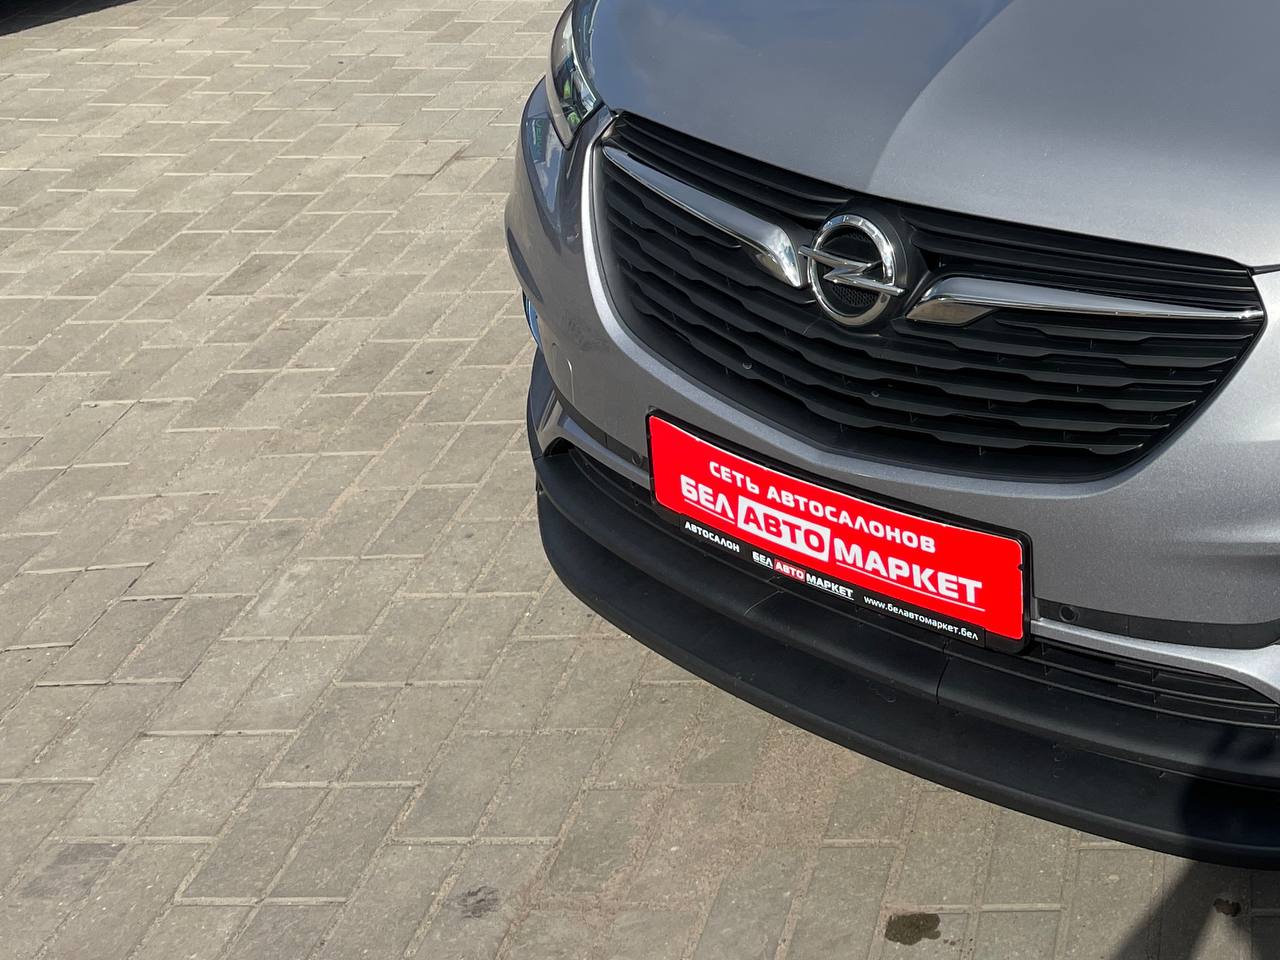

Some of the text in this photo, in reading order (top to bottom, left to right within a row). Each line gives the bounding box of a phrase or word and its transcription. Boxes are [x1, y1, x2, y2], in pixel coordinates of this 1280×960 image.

[709, 461, 936, 553] СЕТЬ АВТОСАЛОНОВ
[680, 474, 983, 604] БЕЛ АВТО МАРКЕТ
[684, 521, 740, 553] АВТОСАЛОН
[752, 551, 854, 598] БЕЛ АВТО МАРКЕТ
[863, 596, 979, 641] www.белавтомаркет.бел
